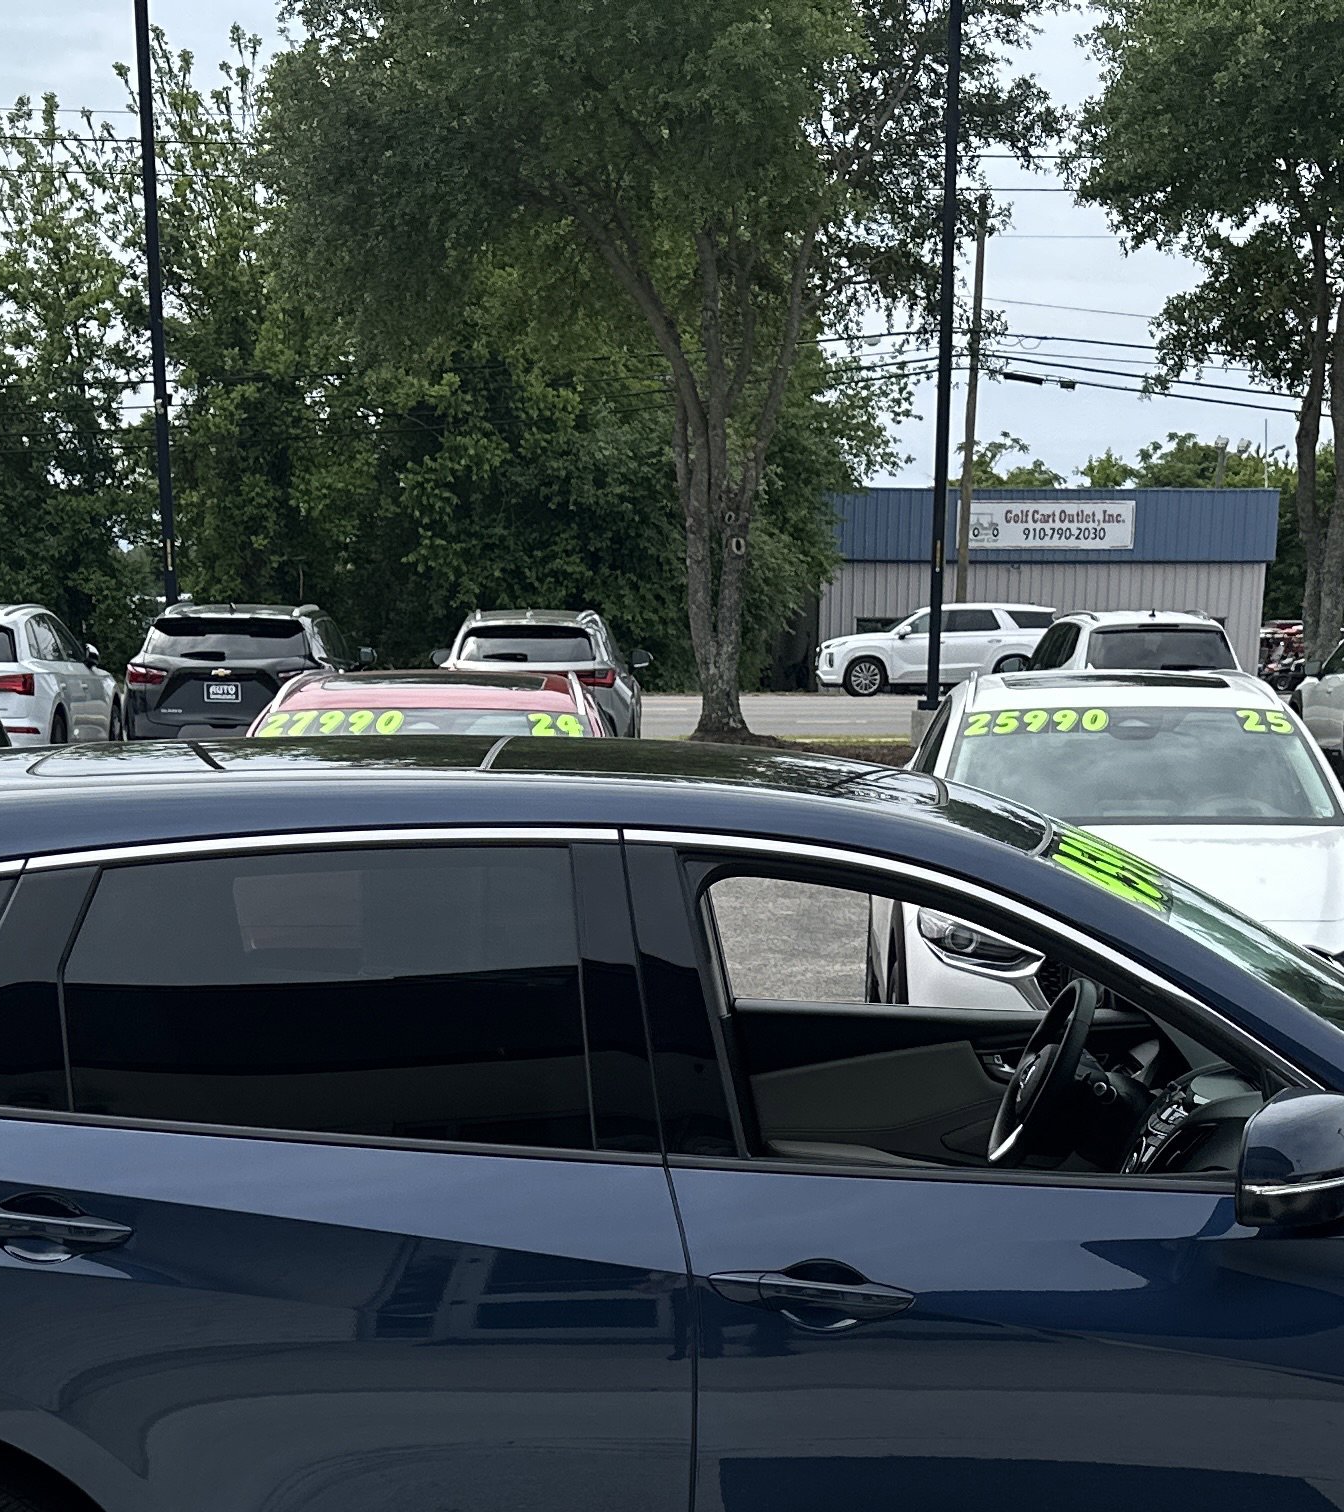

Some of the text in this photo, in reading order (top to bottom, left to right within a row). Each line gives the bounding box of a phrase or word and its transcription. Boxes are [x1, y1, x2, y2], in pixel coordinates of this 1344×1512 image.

[1004, 509, 1029, 524] Golf
[1031, 509, 1056, 524] Cart
[1023, 527, 1106, 541] 910-790-2030
[209, 685, 236, 694] AUTO
[259, 710, 584, 737] 27990 24
[964, 709, 1295, 736] 25990 25
